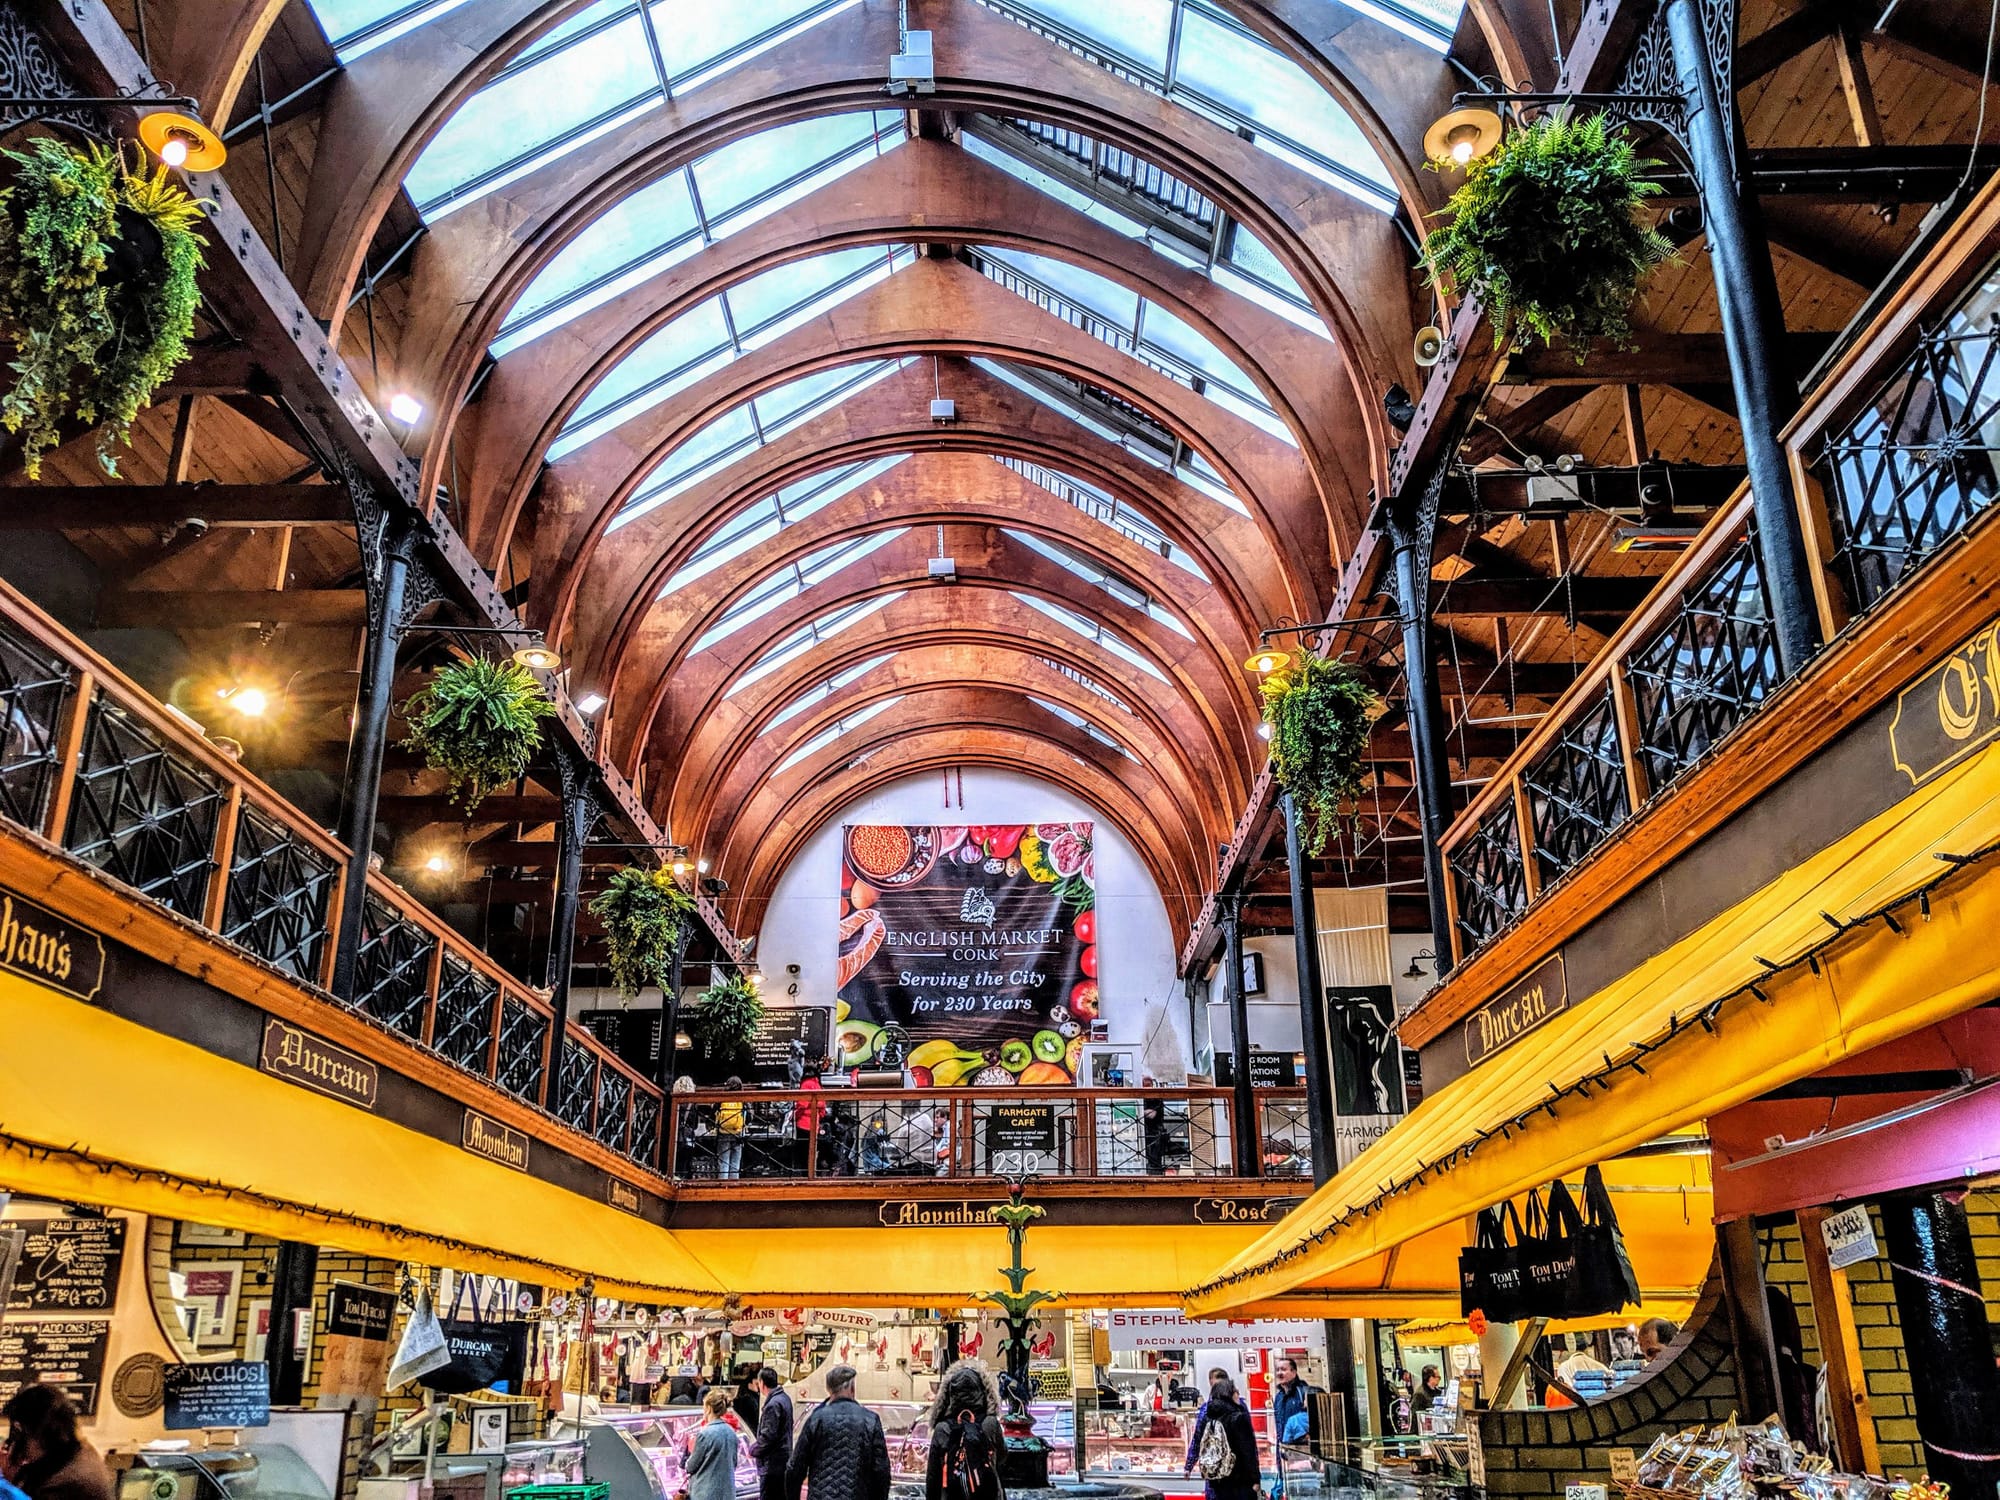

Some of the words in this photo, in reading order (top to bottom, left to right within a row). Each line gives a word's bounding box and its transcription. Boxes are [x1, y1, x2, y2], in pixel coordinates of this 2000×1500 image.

[887, 931, 974, 947] ENGLISH
[981, 929, 1064, 945] MARKET
[952, 948, 999, 961] CORK
[898, 971, 970, 988] Serving
[975, 971, 1003, 986] the
[1009, 969, 1046, 988] City
[911, 995, 939, 1014] for
[944, 996, 975, 1011] 230
[981, 996, 1033, 1011] Years
[1478, 984, 1549, 1053] Durcan
[278, 1028, 372, 1097] Durcan
[998, 1108, 1048, 1117] FARMGATE
[1010, 1117, 1036, 1127] CAFÉ
[1336, 1127, 1395, 1138] FARMGA
[467, 1116, 524, 1165] Moynihan
[992, 1151, 1039, 1174] 230
[896, 1201, 999, 1225] Moynihan
[1490, 1272, 1513, 1285] TOM
[1529, 1264, 1551, 1279] TOM
[344, 1298, 360, 1316] TOM
[815, 1310, 874, 1326] POULTRY
[1114, 1314, 1217, 1326] STEPHENS
[65, 1323, 85, 1333] ONS
[451, 1337, 493, 1352] DURCAN
[1136, 1337, 1175, 1346] BACON
[1179, 1337, 1203, 1345] AND
[1207, 1336, 1239, 1344] PORK
[1243, 1335, 1309, 1344] SPECIALIST
[451, 1349, 487, 1358] MARKET
[189, 1364, 265, 1383] NACHOS!
[196, 1412, 223, 1421] ONLY
